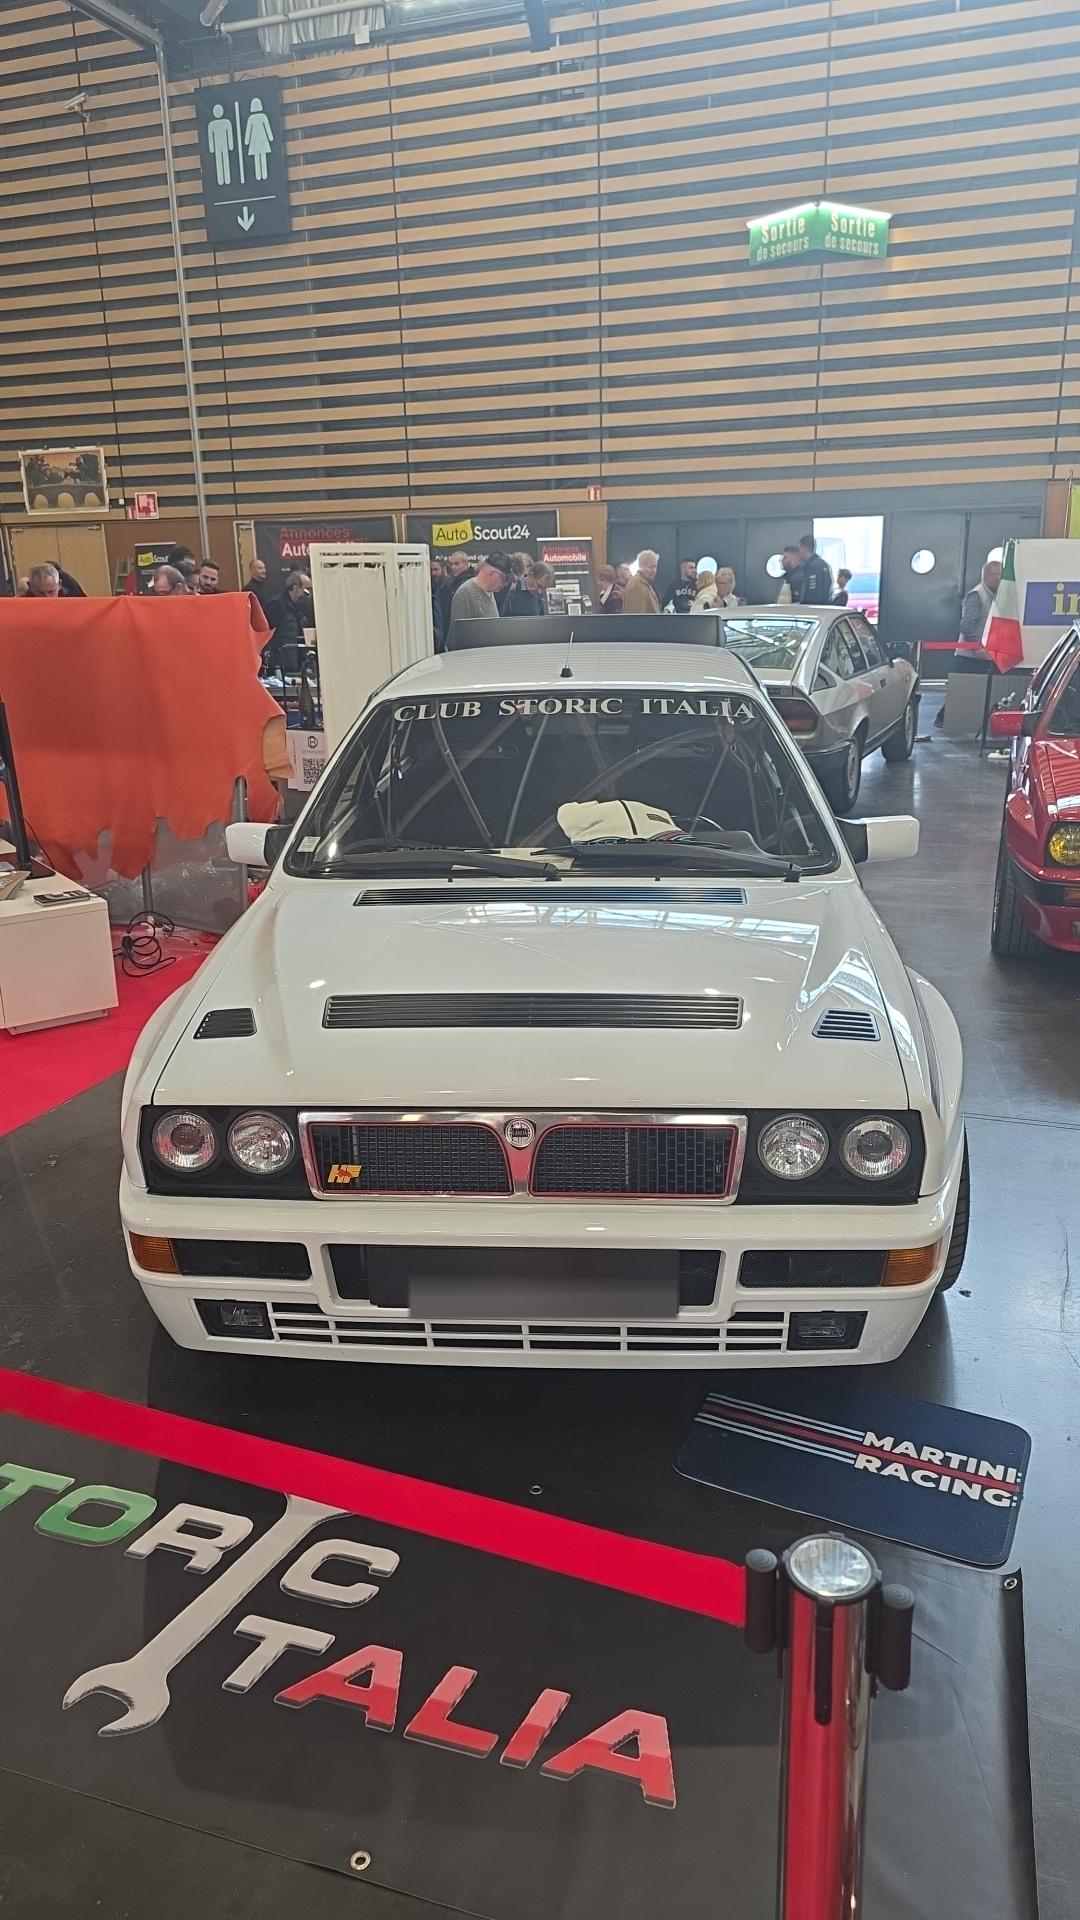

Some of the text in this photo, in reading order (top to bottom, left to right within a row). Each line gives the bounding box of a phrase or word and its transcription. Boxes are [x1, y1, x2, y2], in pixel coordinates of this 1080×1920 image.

[761, 217, 806, 244] Sortie
[831, 211, 876, 238] Sortie
[756, 236, 810, 262] de secours
[825, 233, 879, 256] de secours
[280, 527, 351, 539] Annonces
[543, 552, 587, 563] Automobile
[675, 587, 697, 597] BOSS
[393, 697, 756, 722] CLUB STORIC ITALIA
[862, 1431, 1018, 1484] MARTINI
[853, 1452, 1013, 1508] RACING
